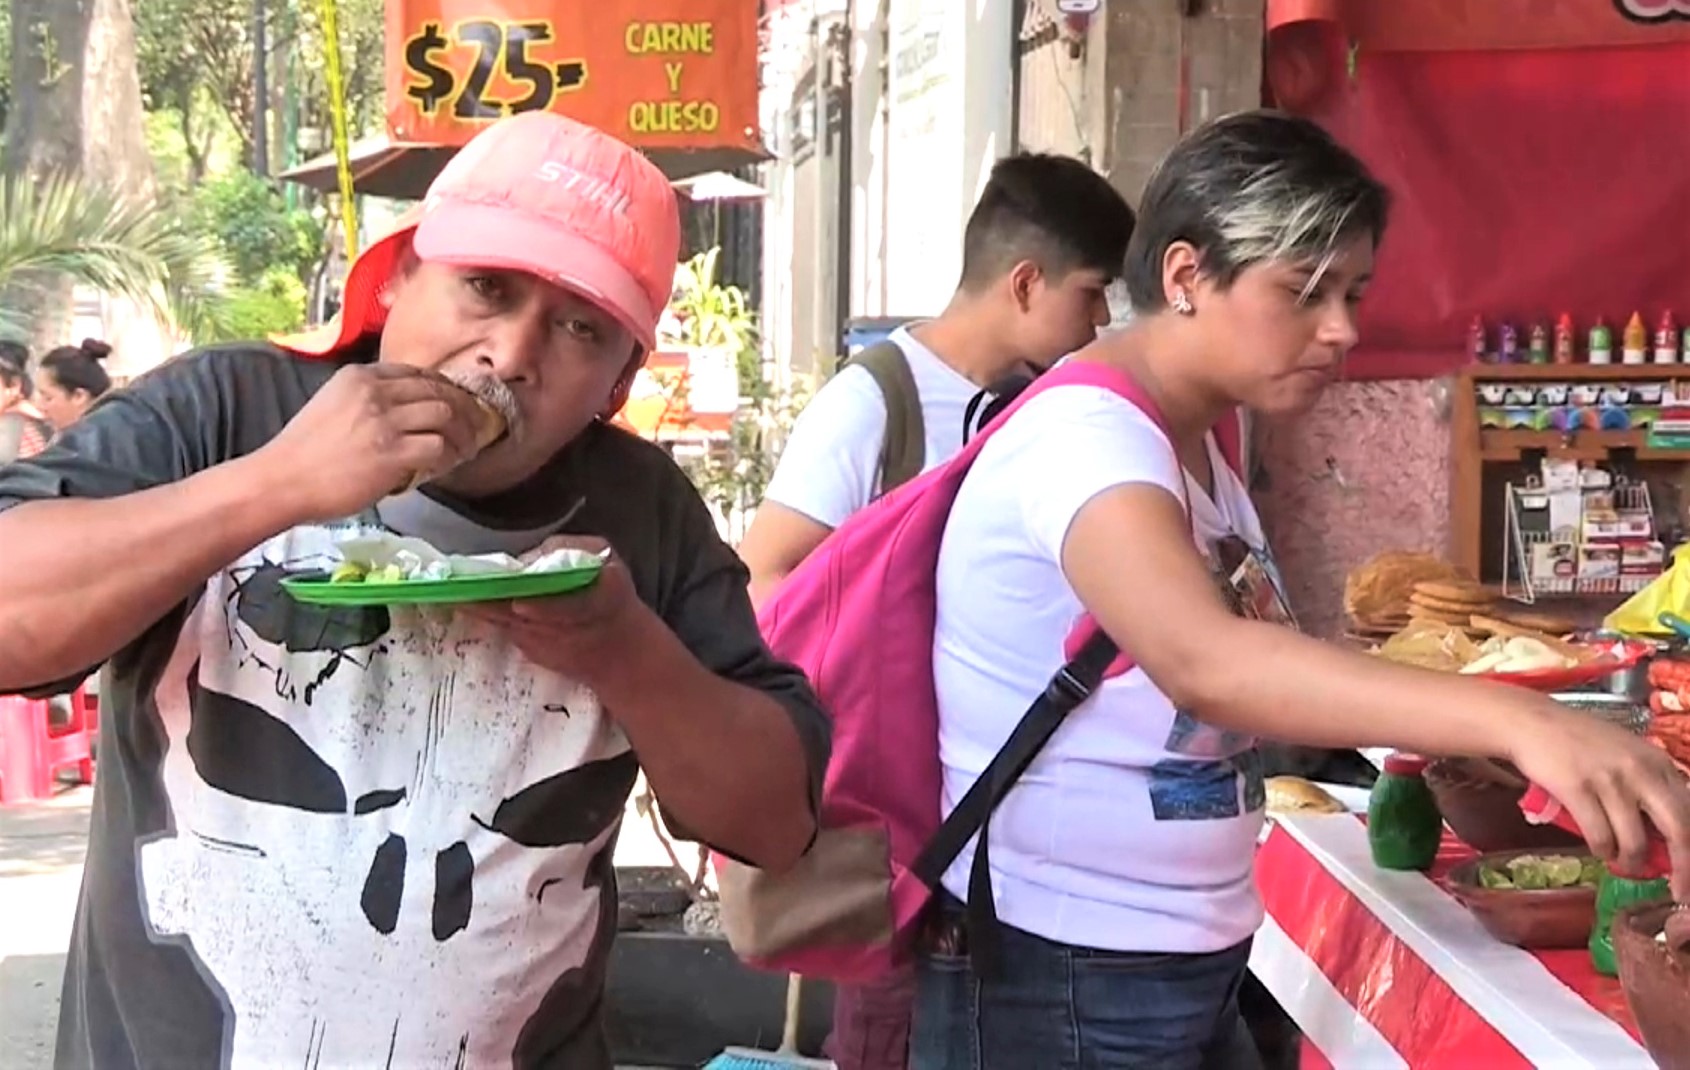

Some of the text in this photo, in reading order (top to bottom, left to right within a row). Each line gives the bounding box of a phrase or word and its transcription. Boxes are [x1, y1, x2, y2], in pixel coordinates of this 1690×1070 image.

[624, 21, 714, 54] CARNE
[664, 61, 683, 93] Y
[628, 100, 720, 133] QUESO
[533, 160, 631, 213] STIHL
